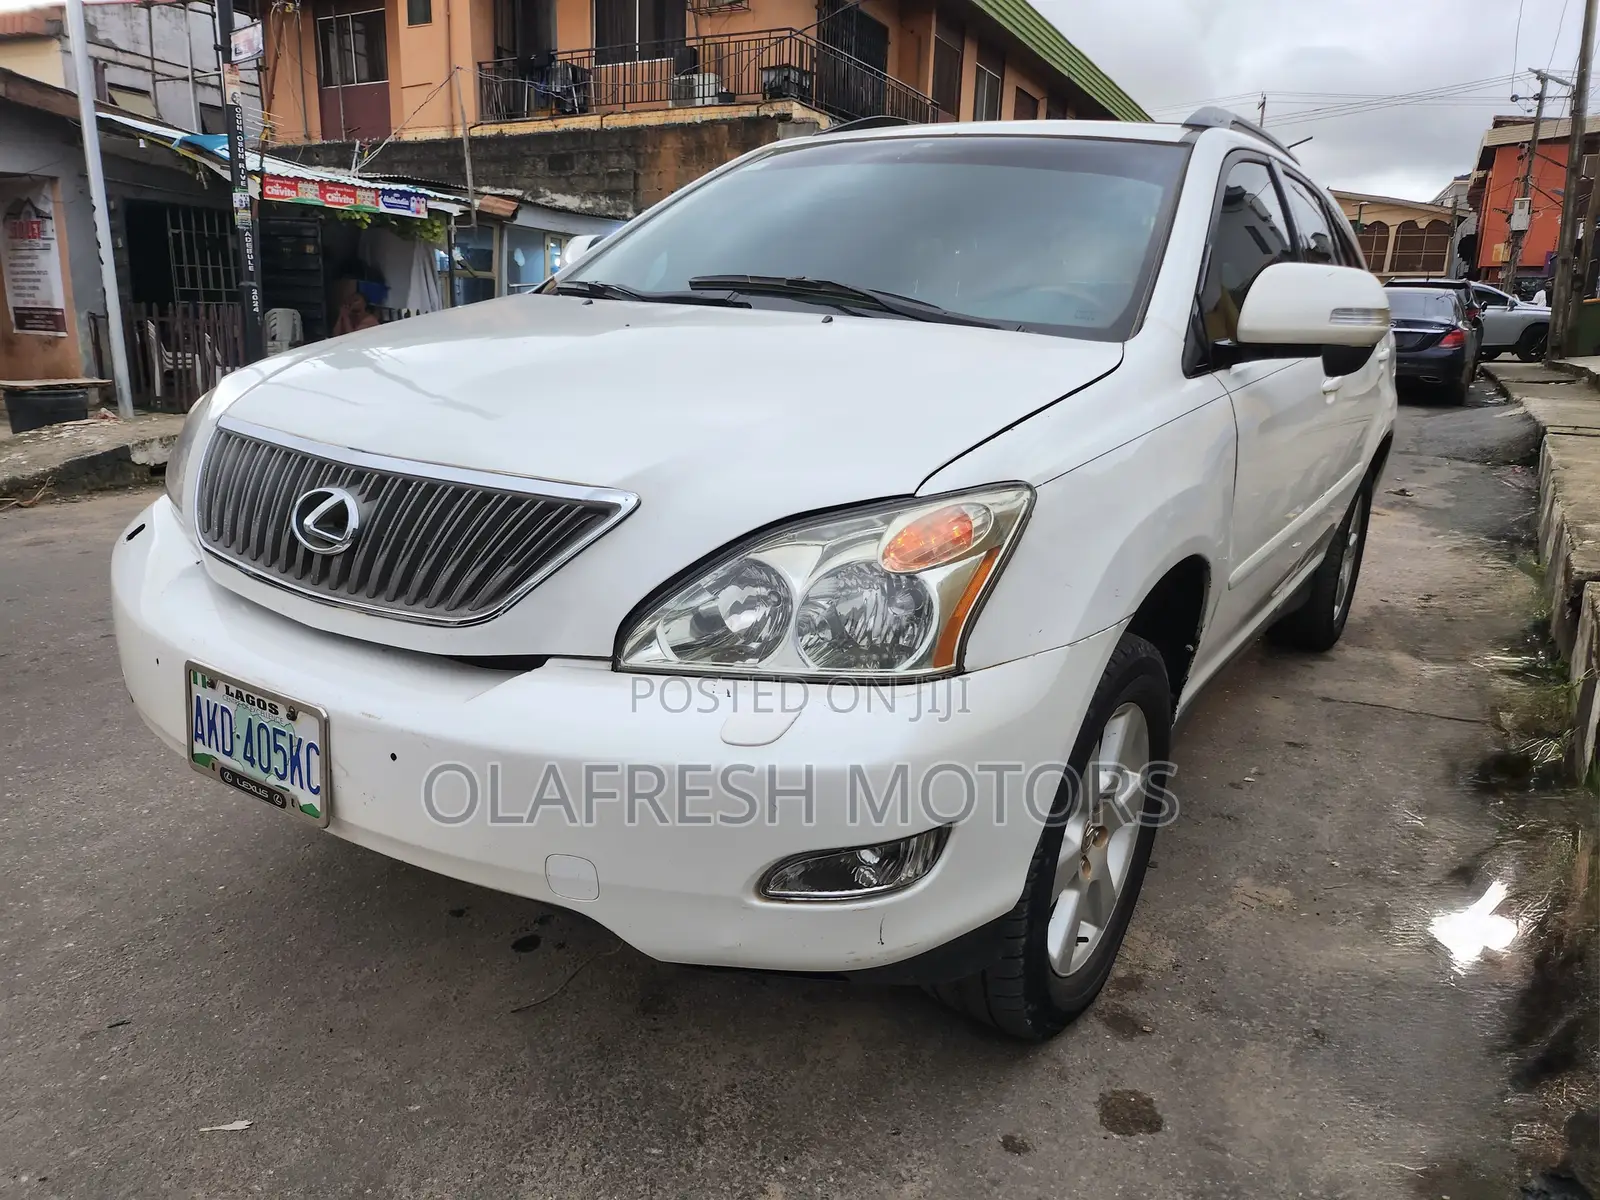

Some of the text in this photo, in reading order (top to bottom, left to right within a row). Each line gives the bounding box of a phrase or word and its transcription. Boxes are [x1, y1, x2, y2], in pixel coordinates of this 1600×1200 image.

[238, 162, 248, 187] RIVE
[265, 185, 297, 197] Chivita
[325, 192, 355, 204] Chivita
[251, 288, 260, 313] 2024
[225, 684, 279, 716] LAGOS
[194, 694, 320, 796] AKD-405KC
[236, 778, 269, 799] LEXUS
